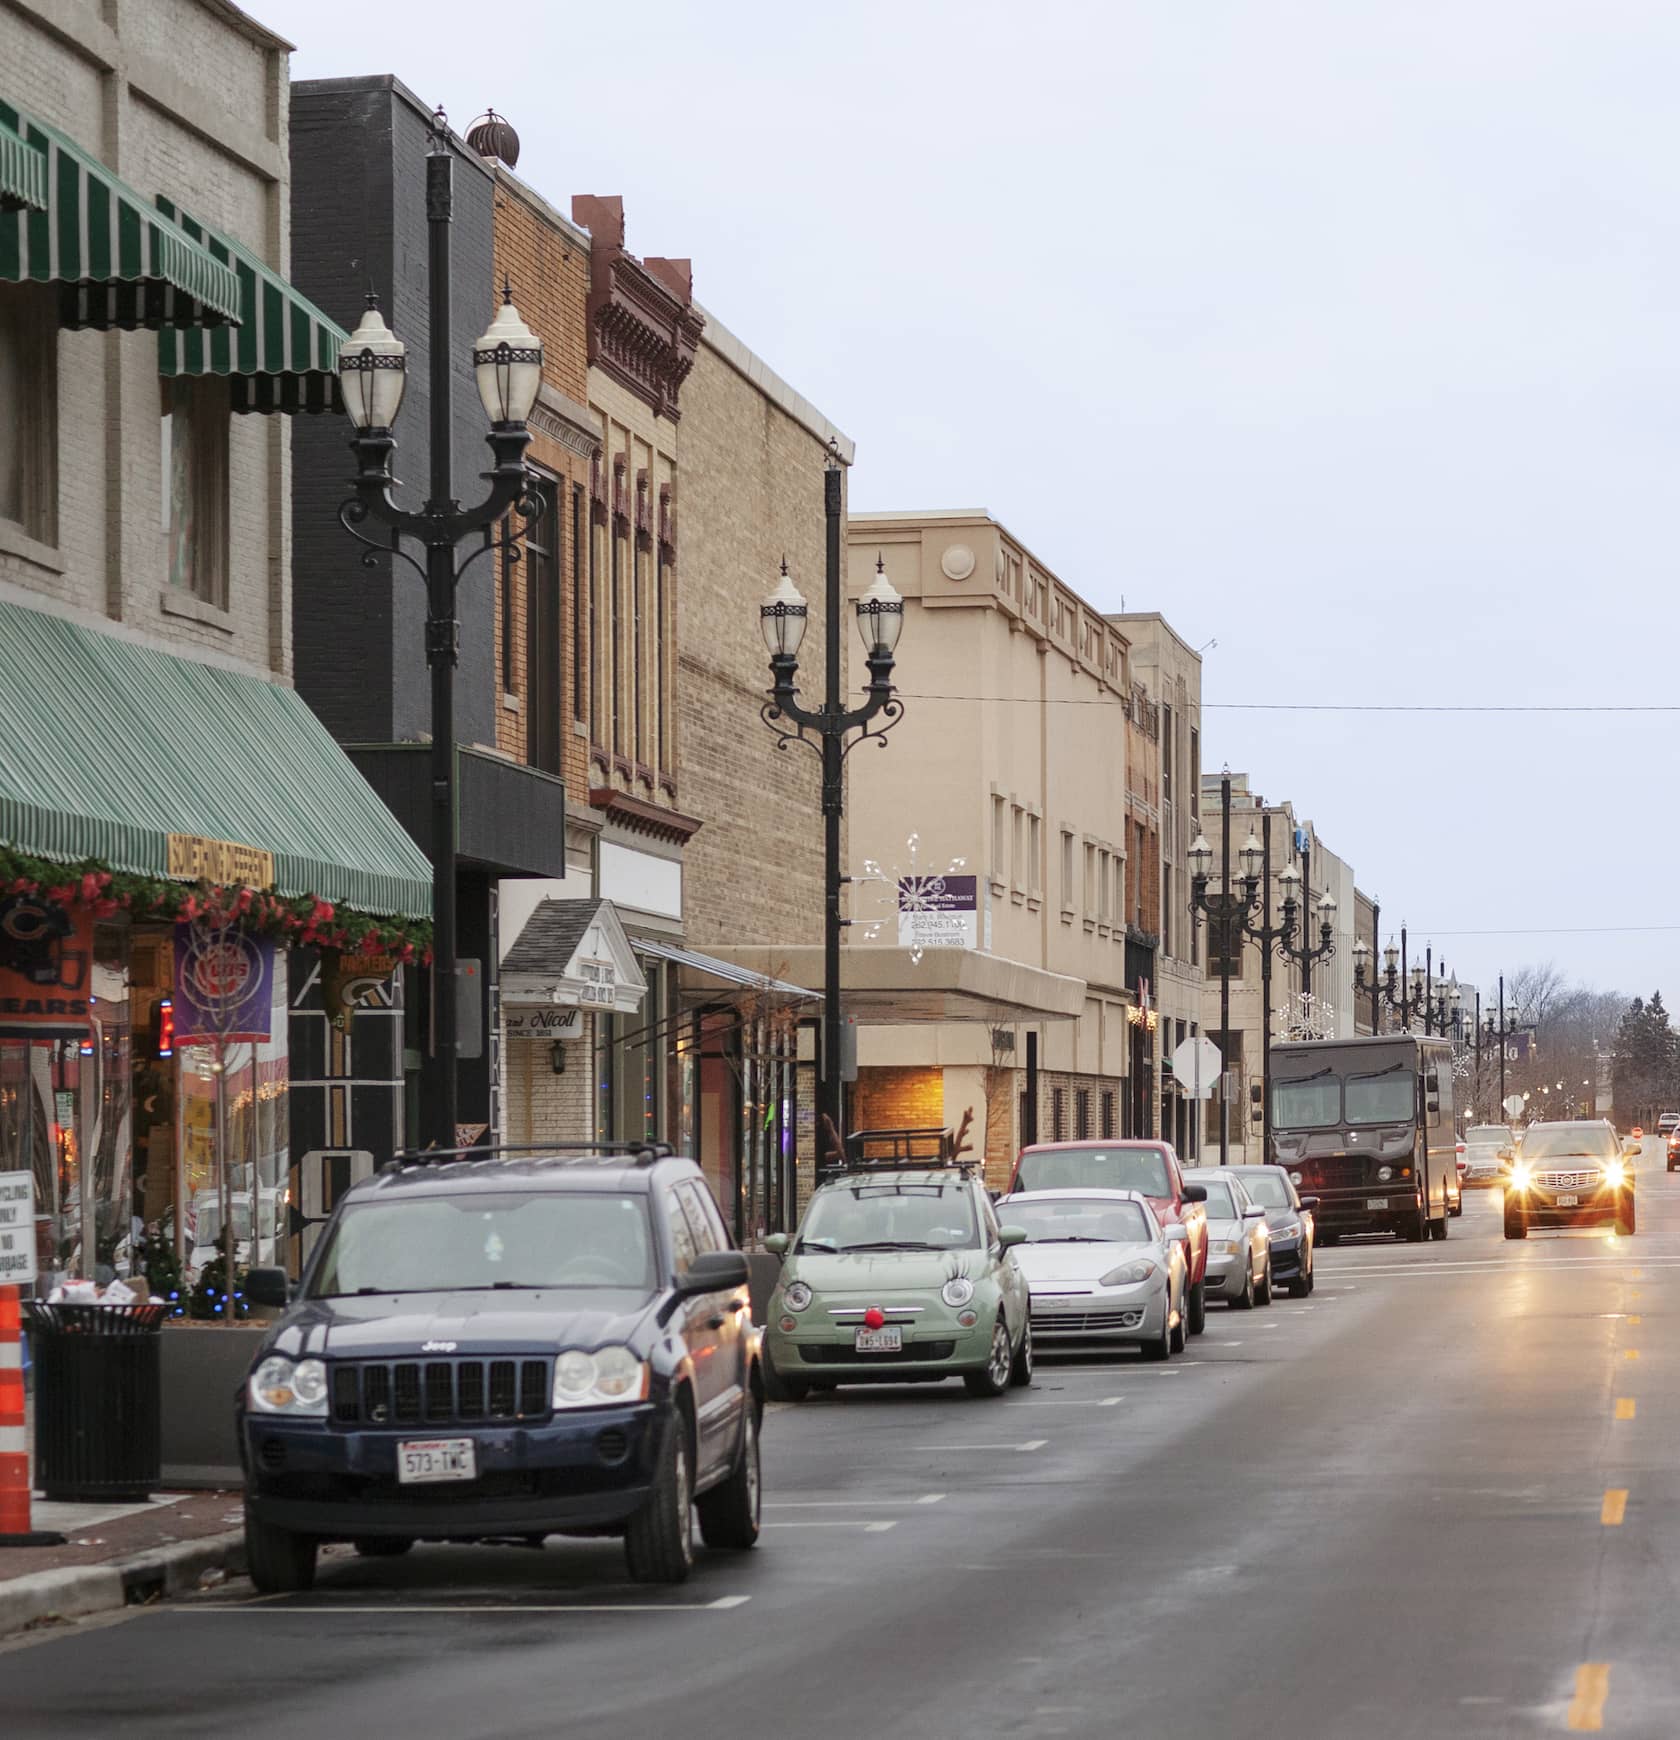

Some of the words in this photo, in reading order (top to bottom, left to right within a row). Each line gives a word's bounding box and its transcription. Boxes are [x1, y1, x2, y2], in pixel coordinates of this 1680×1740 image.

[530, 1010, 577, 1028] Nicoll
[421, 1339, 457, 1353] Jeep
[406, 1450, 466, 1473] 573-TWC
